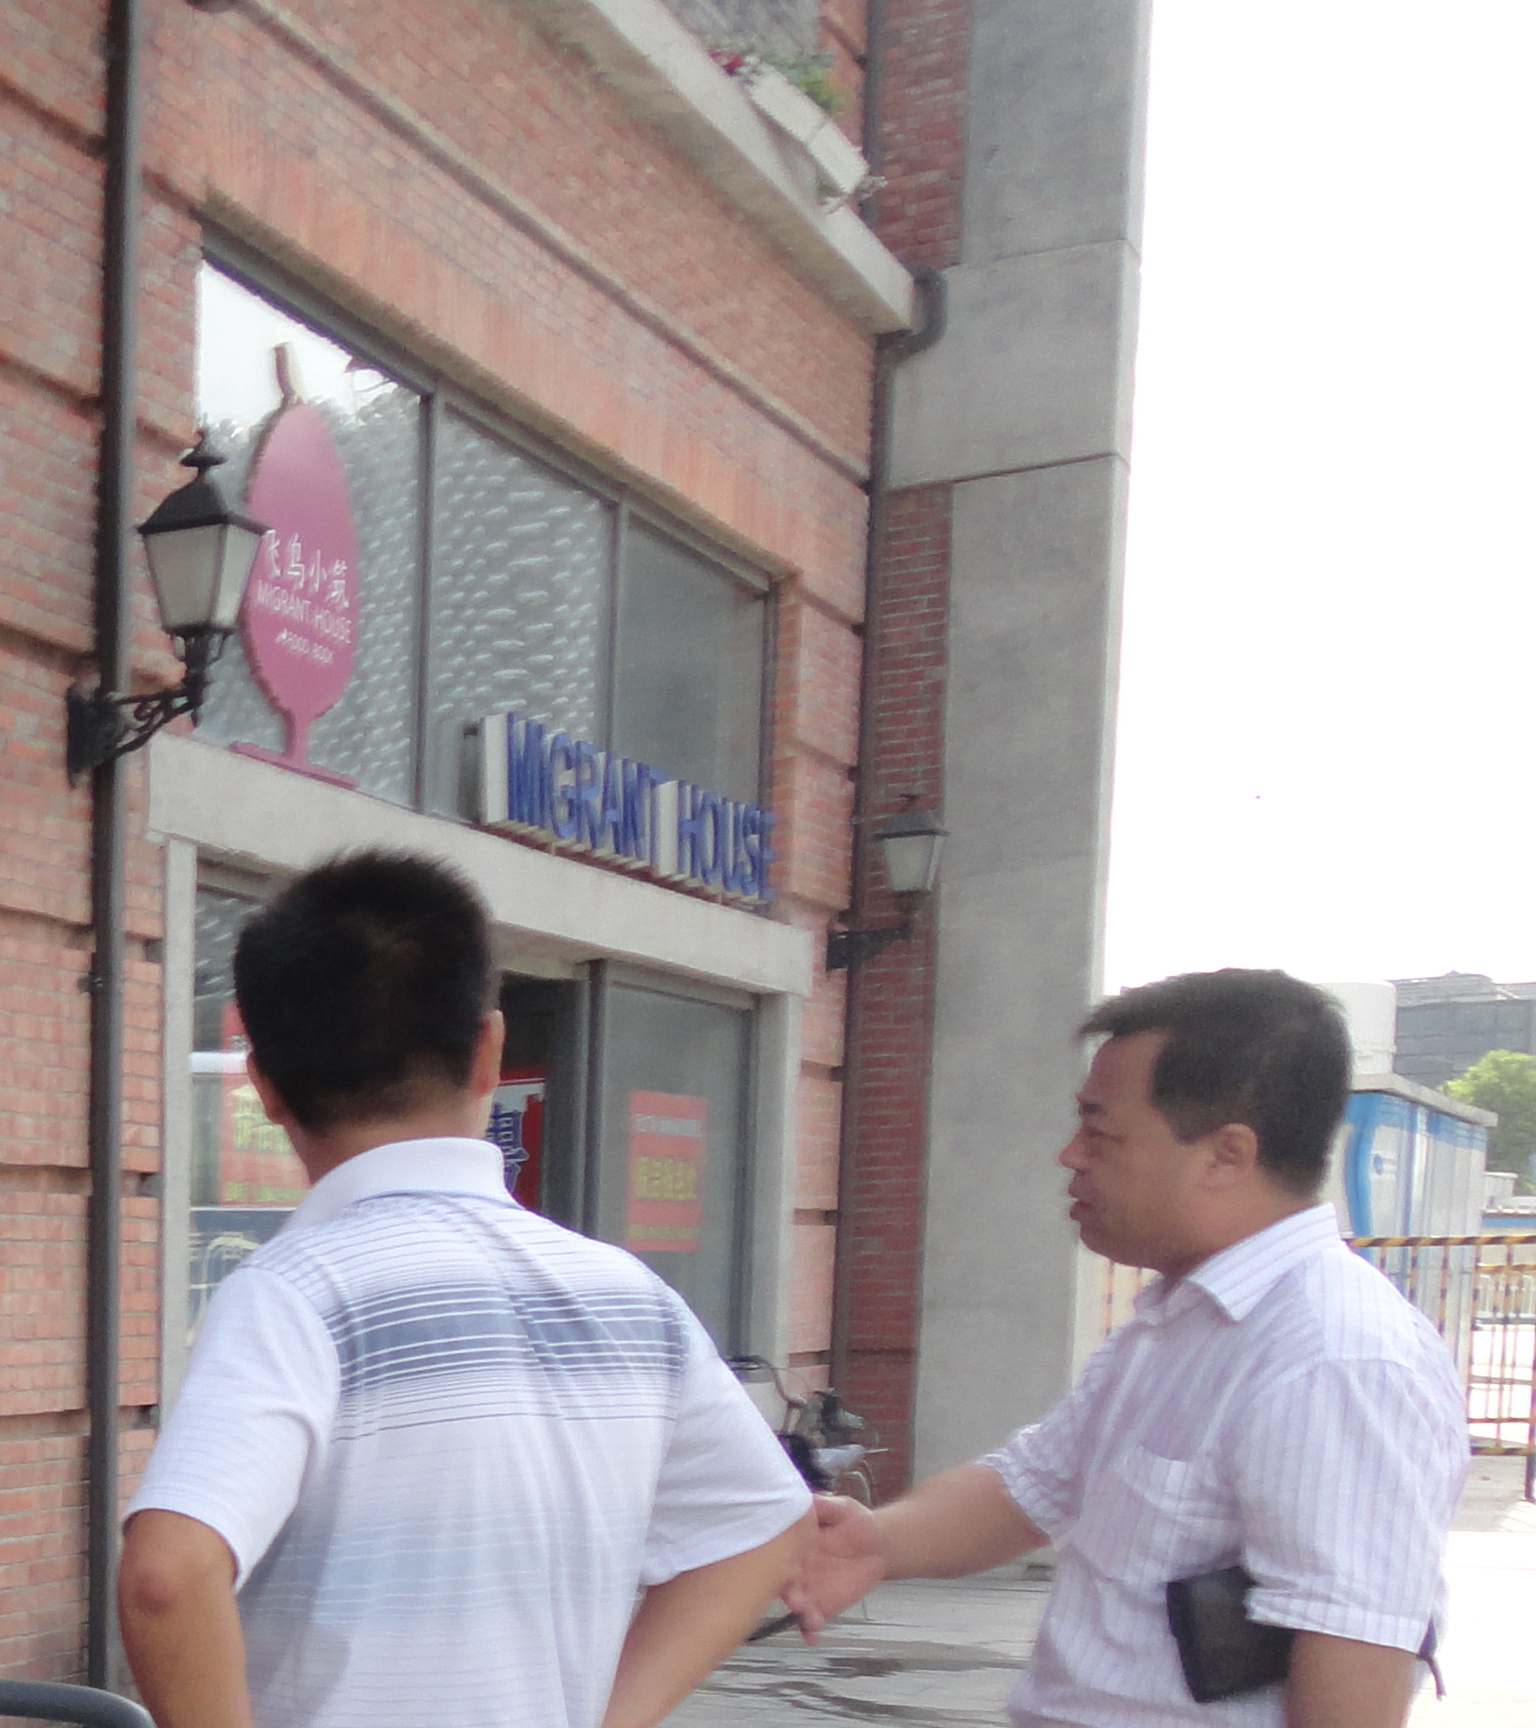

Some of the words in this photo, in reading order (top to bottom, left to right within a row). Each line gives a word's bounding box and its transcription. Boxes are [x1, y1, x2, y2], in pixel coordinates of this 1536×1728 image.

[256, 578, 312, 623] MIGRANT
[314, 605, 353, 645] HOUSE
[506, 711, 668, 868] MIGRANT
[677, 778, 776, 902] HOUSE
